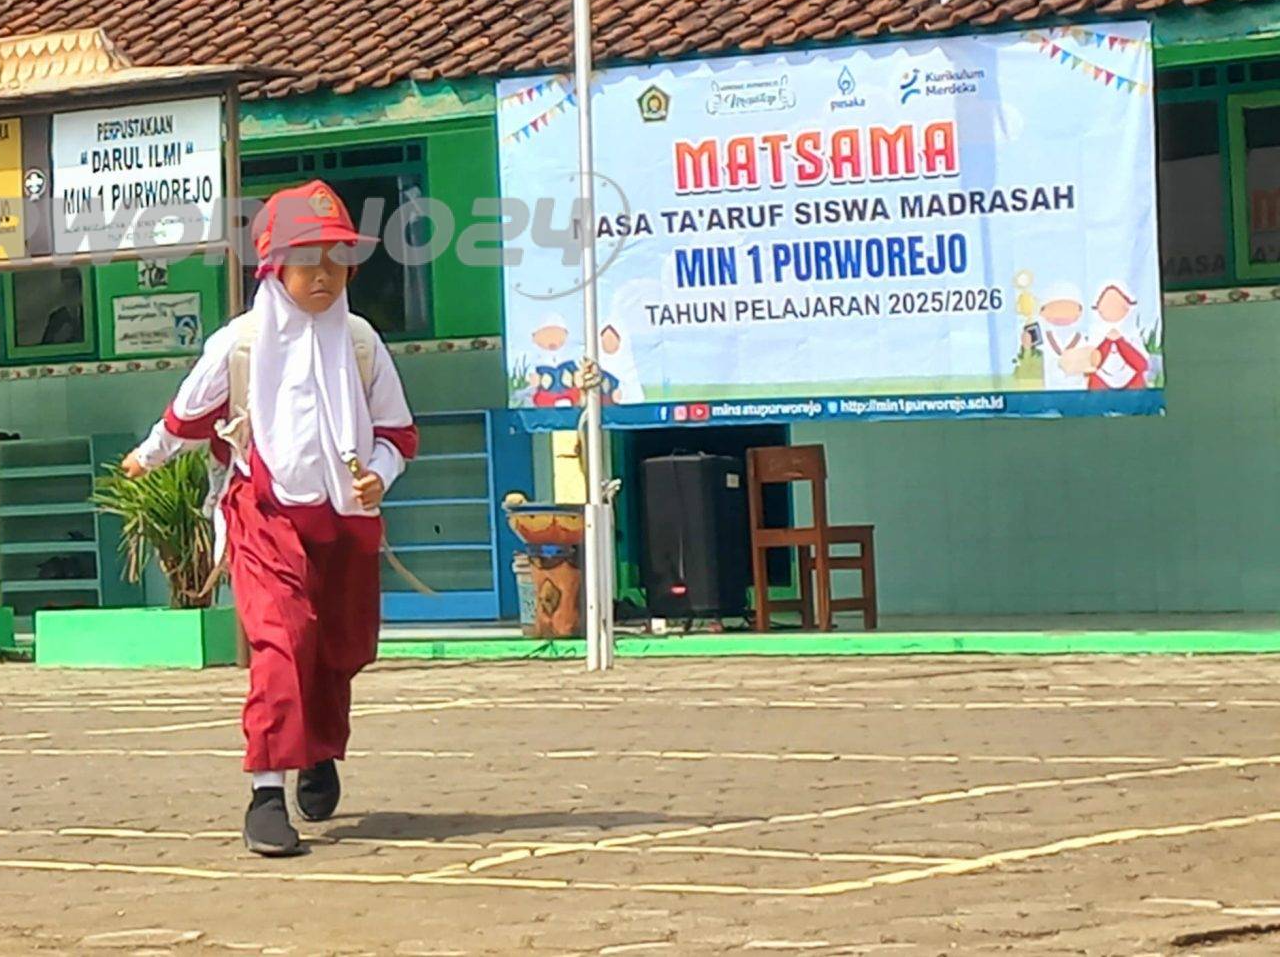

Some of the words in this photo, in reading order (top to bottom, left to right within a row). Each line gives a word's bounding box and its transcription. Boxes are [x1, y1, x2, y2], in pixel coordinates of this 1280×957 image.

[925, 69, 984, 82] Kurikulum
[925, 83, 977, 96] Merdeka
[675, 121, 958, 190] MATSAMA
[63, 186, 92, 215] MIN
[97, 185, 105, 212] 1
[111, 175, 213, 211] PURWOREJO
[661, 203, 784, 235] TA'ARUF
[794, 197, 890, 226] SISWA
[900, 185, 1076, 219] MADRASAH
[675, 245, 737, 288] MIN
[747, 244, 764, 284] 1
[773, 233, 968, 282] PURWOREJO
[645, 300, 727, 327] TAHUN
[735, 294, 881, 322] PELAJARAN
[888, 288, 1003, 314] 2025/2026
